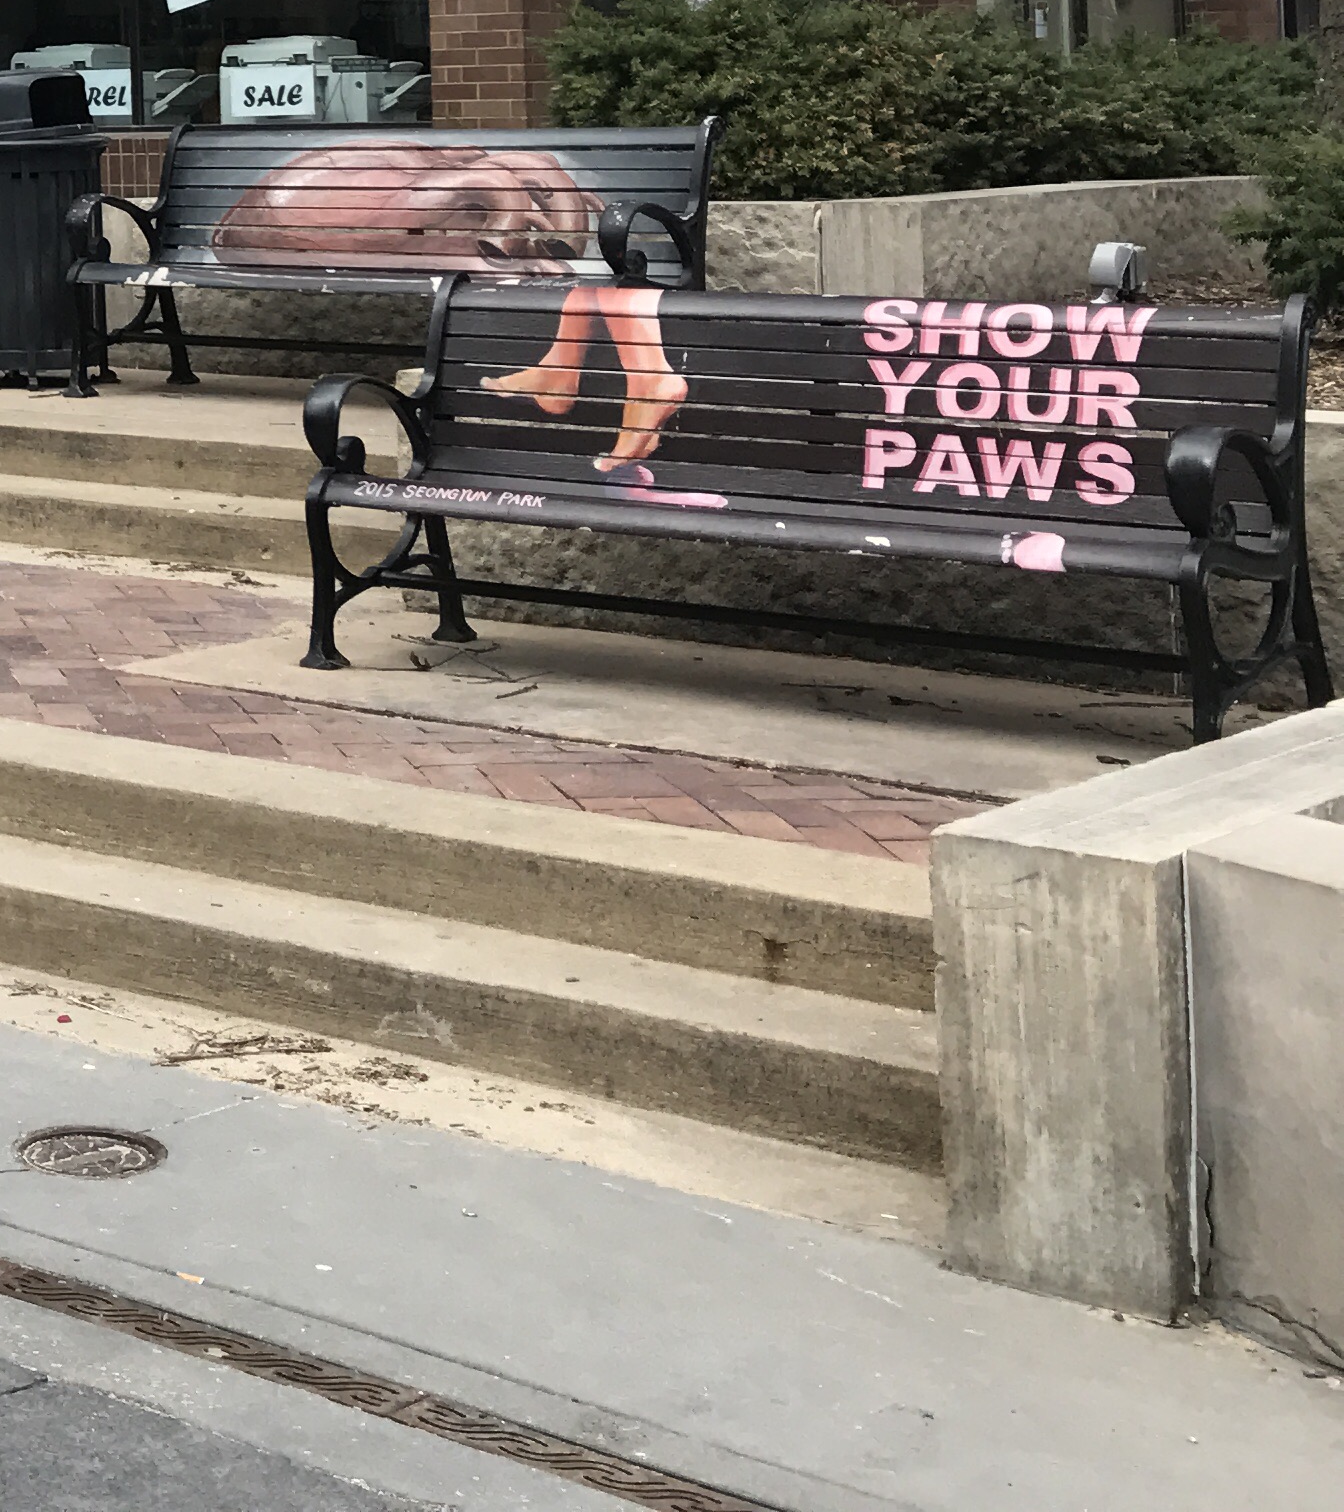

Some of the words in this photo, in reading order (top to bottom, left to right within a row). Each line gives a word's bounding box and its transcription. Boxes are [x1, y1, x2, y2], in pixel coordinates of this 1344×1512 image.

[243, 84, 304, 108] SALE
[863, 299, 1159, 362] SHOW
[867, 358, 1141, 428] YOUR
[353, 480, 395, 498] 2015
[402, 485, 492, 503] SEONGYUN
[496, 491, 547, 508] PARK
[862, 428, 1136, 506] PAWS
